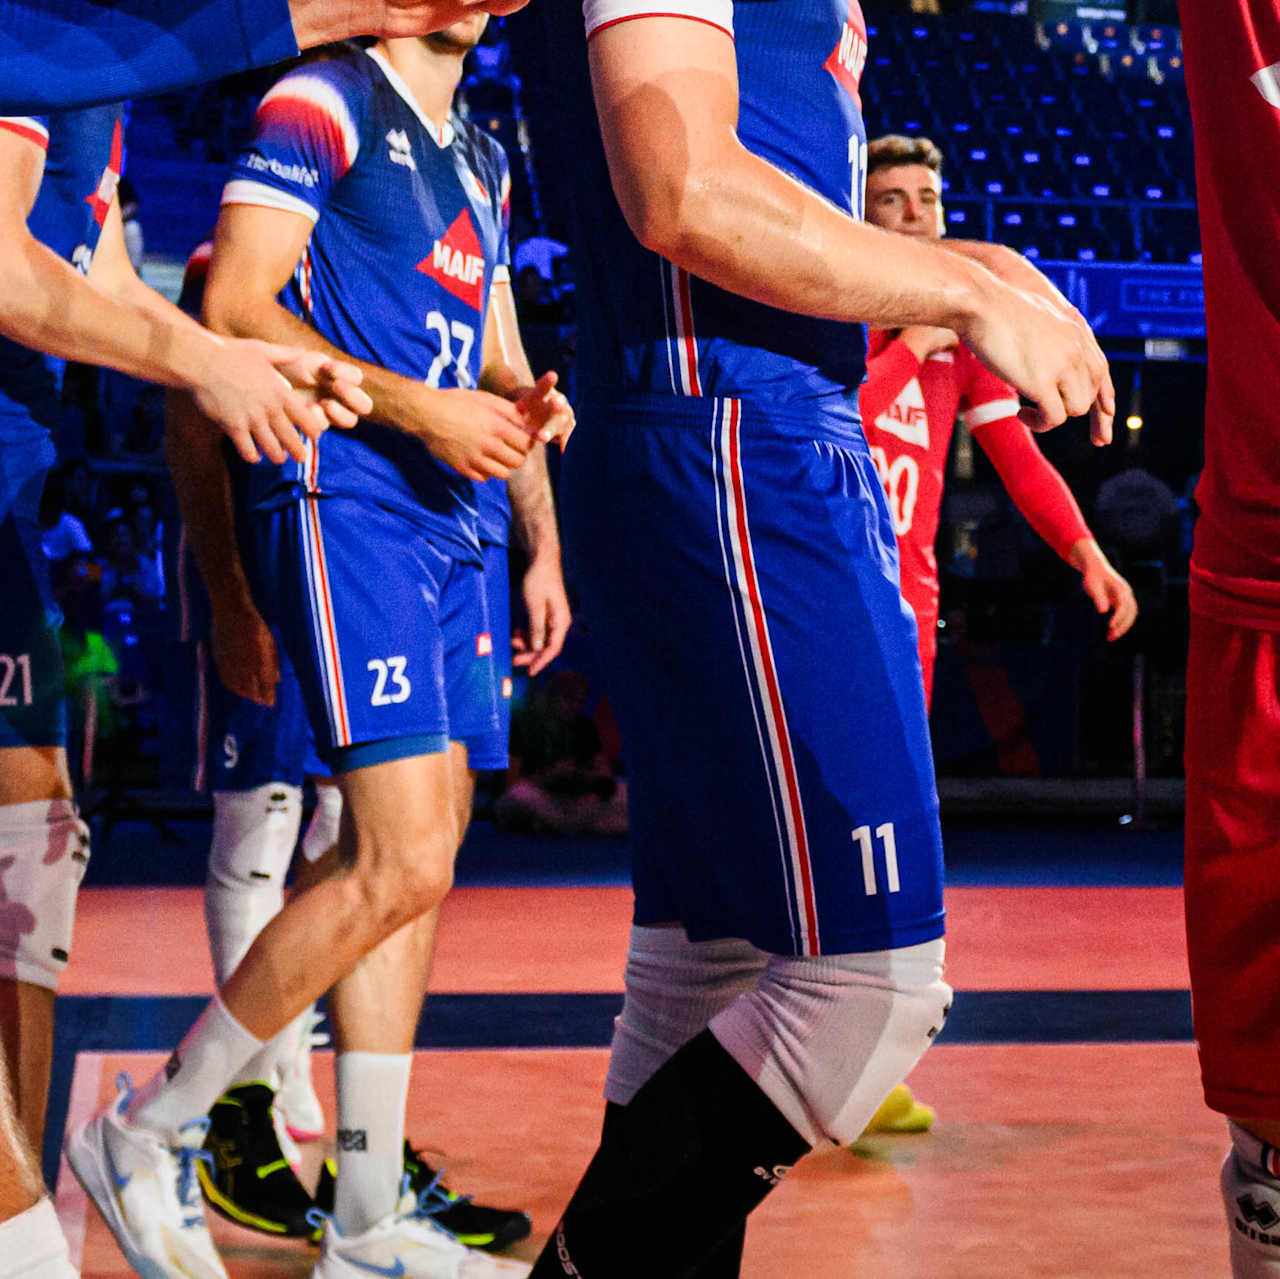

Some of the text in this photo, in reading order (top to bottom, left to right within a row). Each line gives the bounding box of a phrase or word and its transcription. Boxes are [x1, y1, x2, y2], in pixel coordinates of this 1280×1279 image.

[433, 240, 485, 285] MAIF
[367, 656, 411, 706] 23
[851, 822, 900, 896] 11
